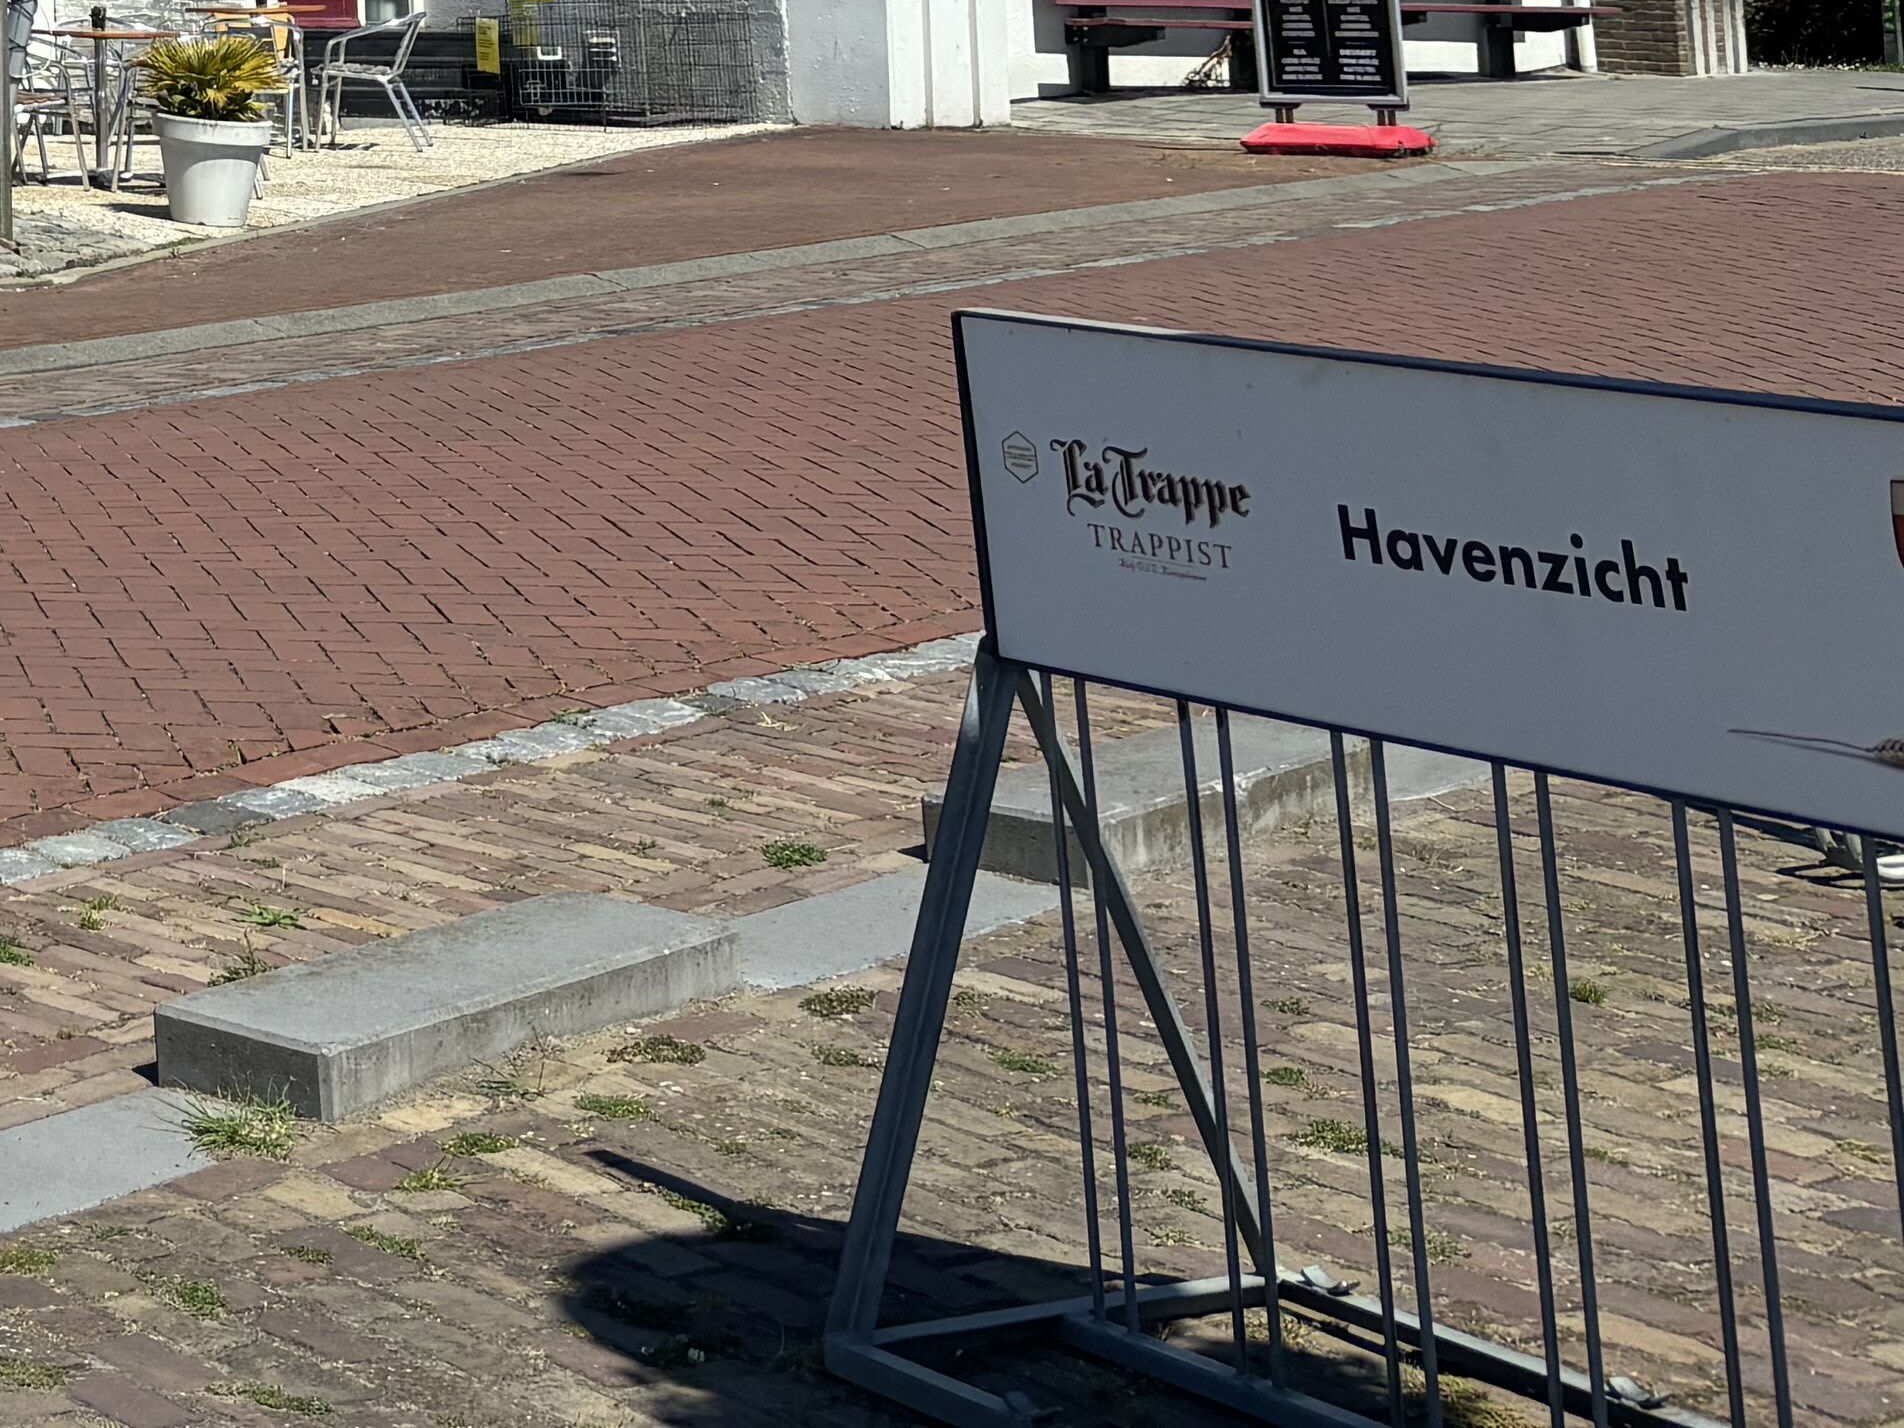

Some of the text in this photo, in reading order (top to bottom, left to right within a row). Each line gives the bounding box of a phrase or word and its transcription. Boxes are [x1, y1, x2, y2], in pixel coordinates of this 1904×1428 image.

[1049, 438, 1252, 530] La Trappe
[1086, 522, 1232, 569] TRAPPIST
[1336, 503, 1689, 612] Havenzicht
